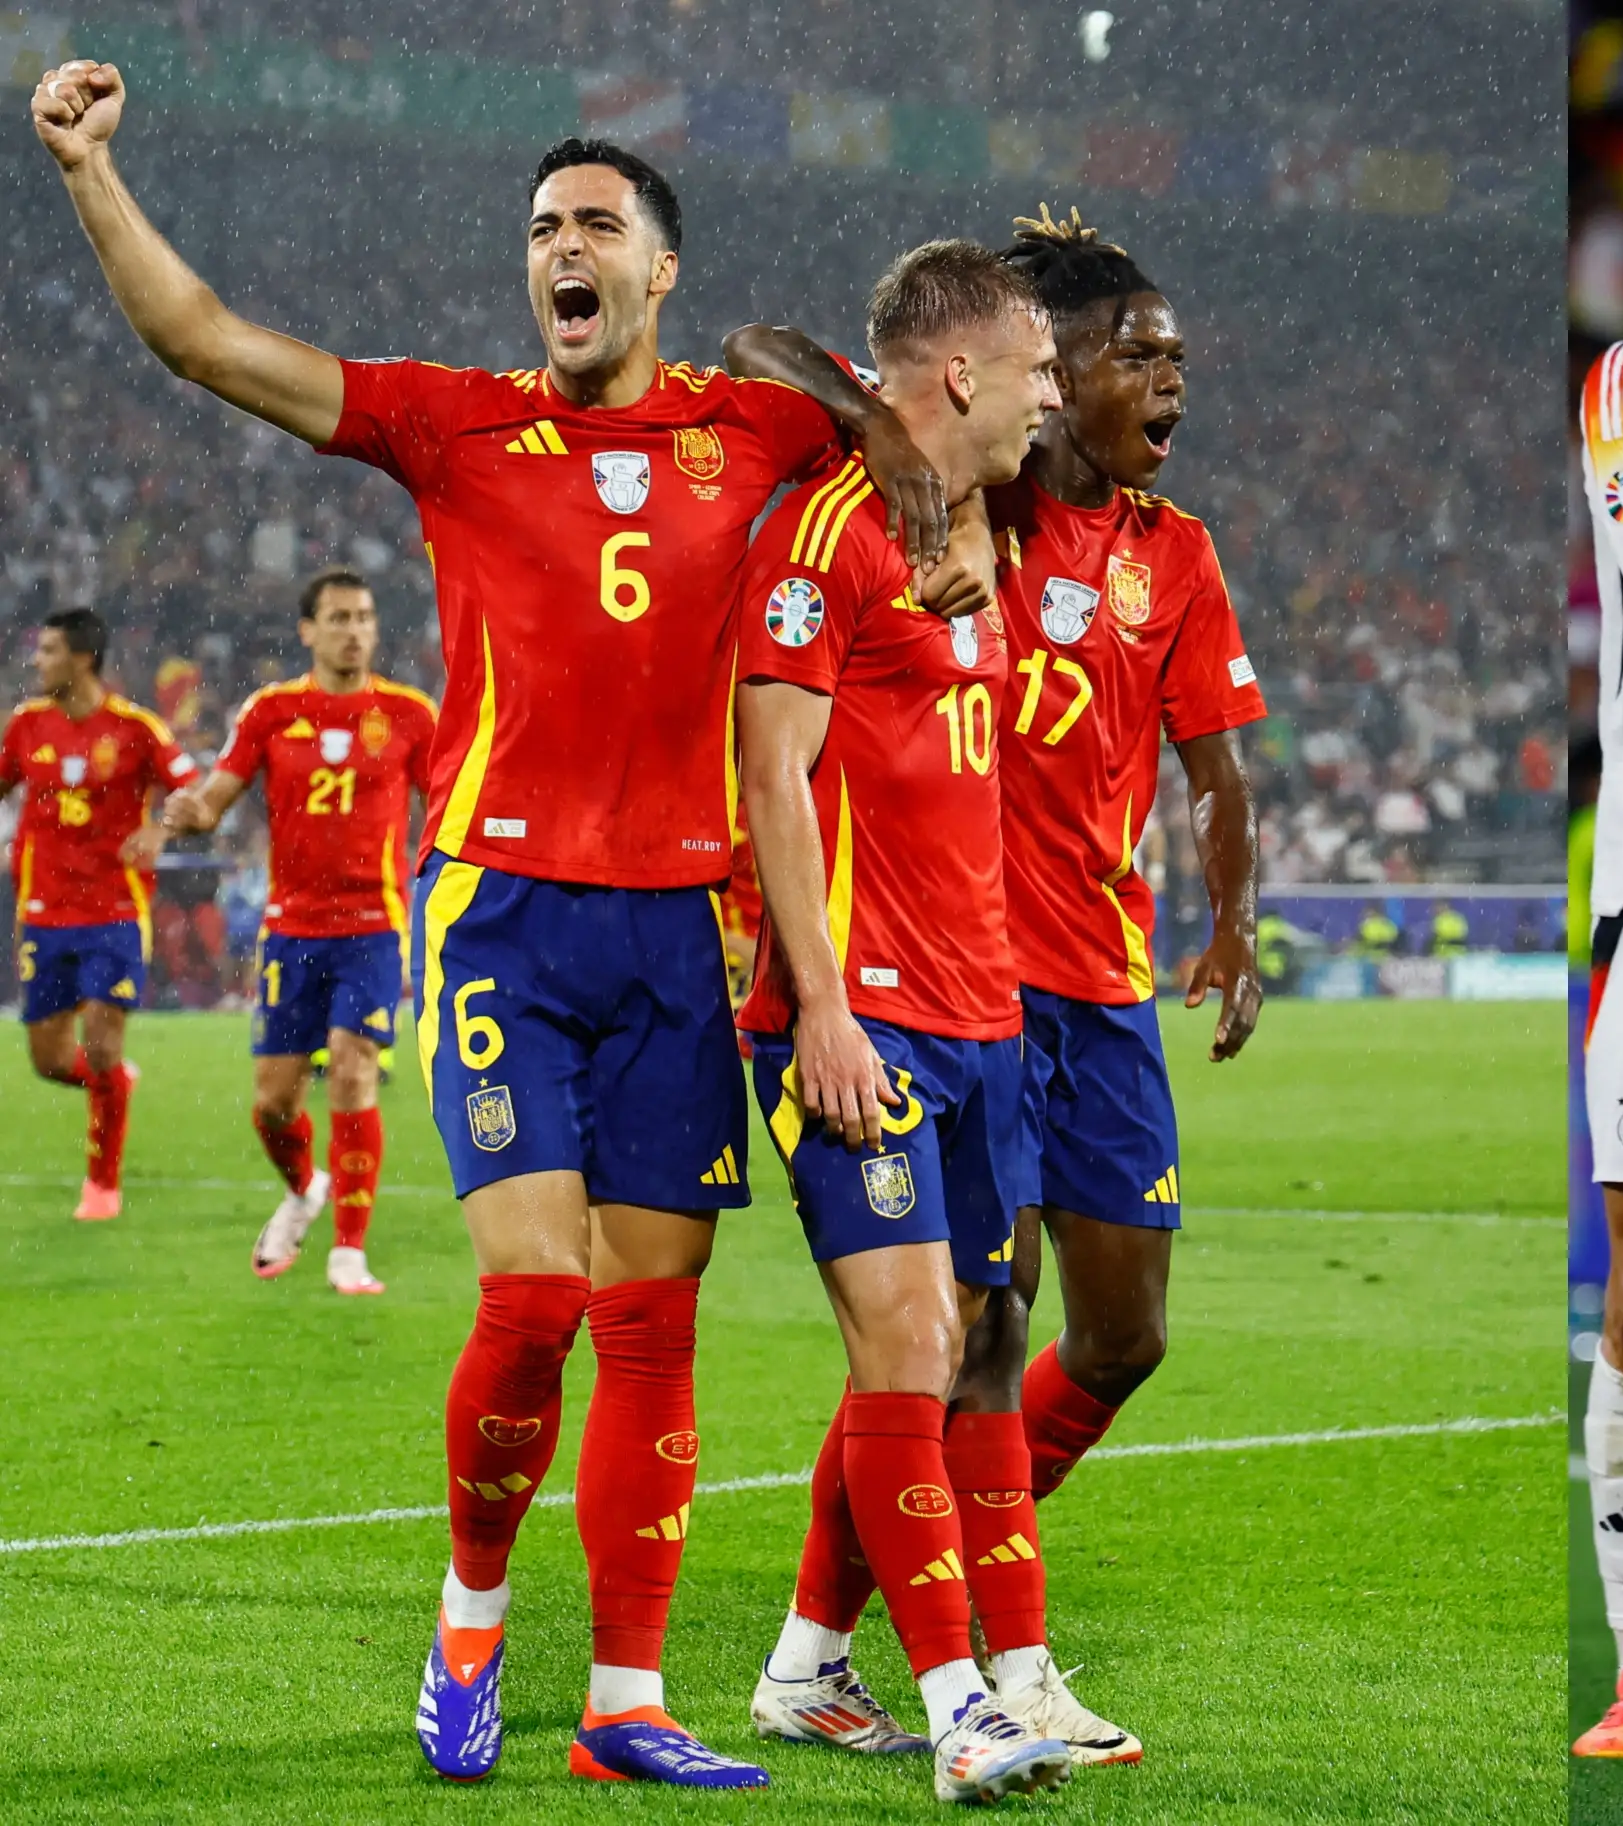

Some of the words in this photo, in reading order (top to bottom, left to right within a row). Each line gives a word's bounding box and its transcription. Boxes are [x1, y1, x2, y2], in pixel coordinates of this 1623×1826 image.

[600, 531, 650, 623] 6
[934, 682, 992, 776] 10
[1014, 648, 1093, 746] 17
[58, 788, 93, 827] 16
[306, 766, 356, 815] 21
[682, 838, 721, 852] HEAT.RDY
[454, 977, 504, 1070] 6
